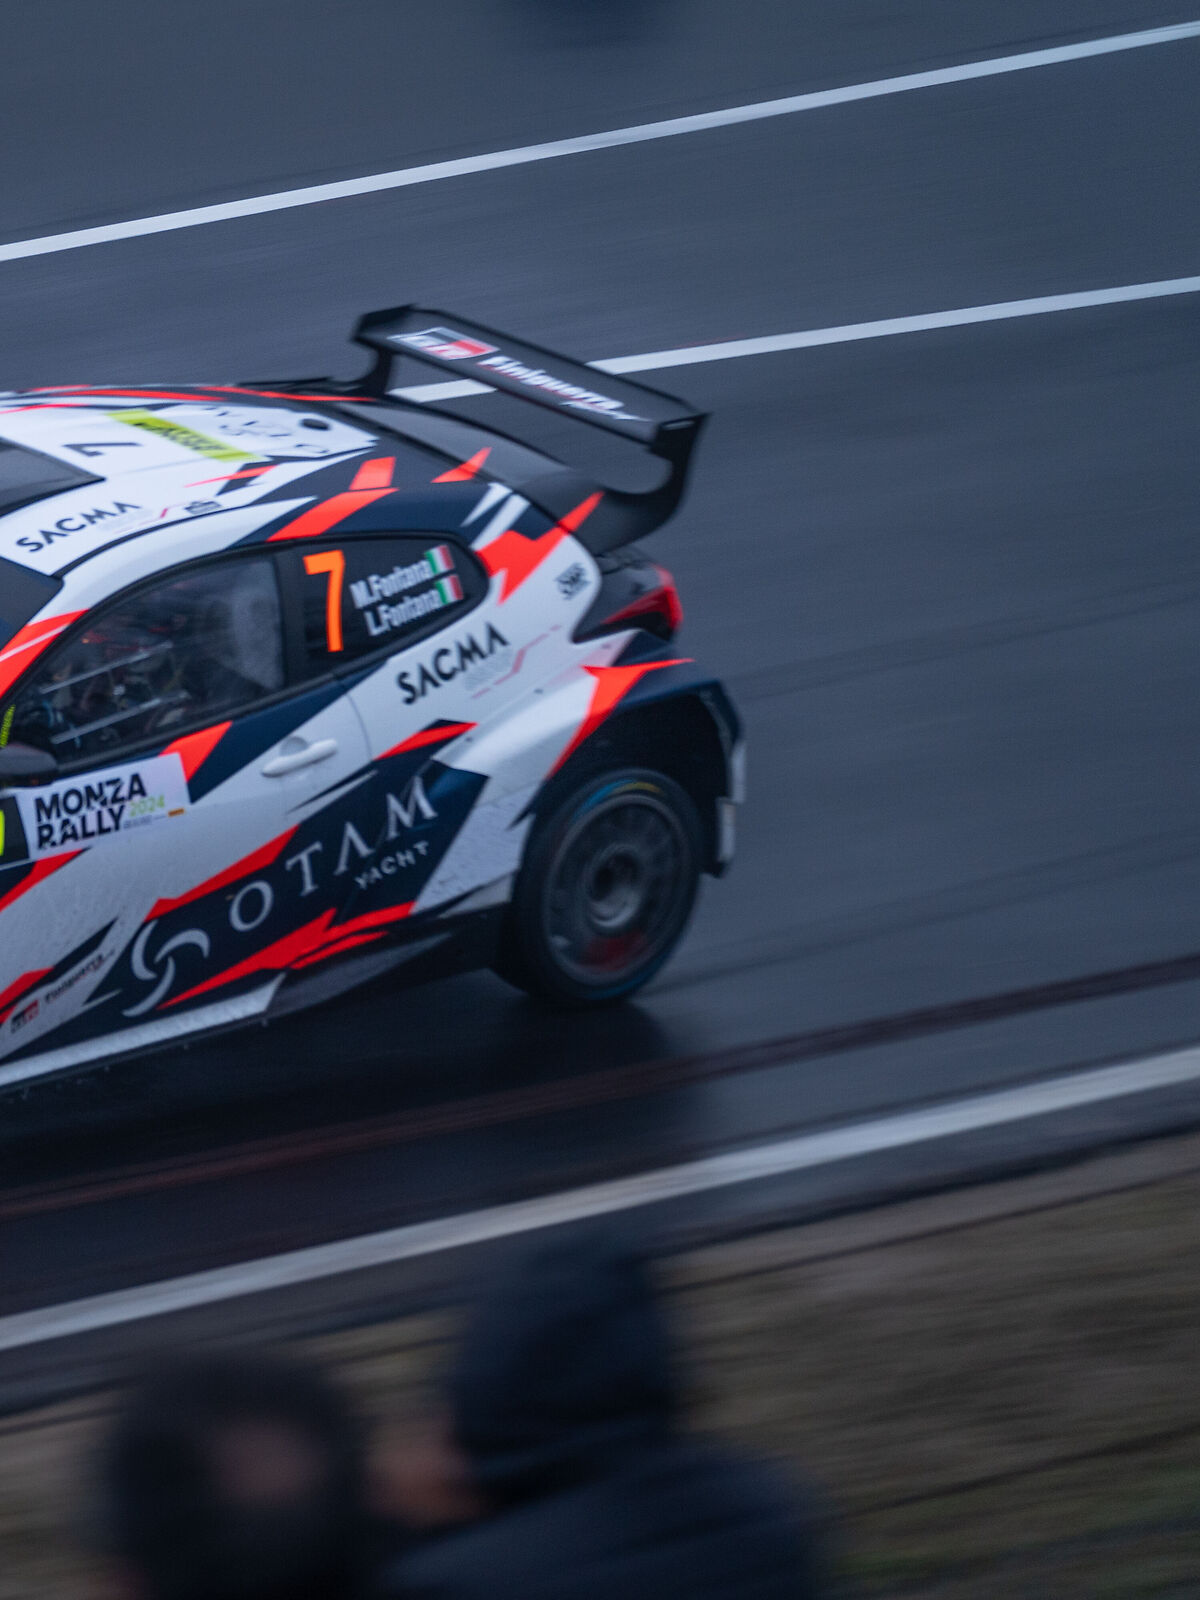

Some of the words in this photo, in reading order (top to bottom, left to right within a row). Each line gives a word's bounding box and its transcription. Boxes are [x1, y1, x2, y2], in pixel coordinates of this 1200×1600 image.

[15, 501, 142, 552] SACMA
[302, 549, 345, 652] 7
[396, 621, 510, 705] SACMA
[33, 772, 148, 824] MONZA
[36, 804, 126, 851] RALLY
[228, 775, 439, 932] OTAM
[354, 840, 430, 889] YACHT
